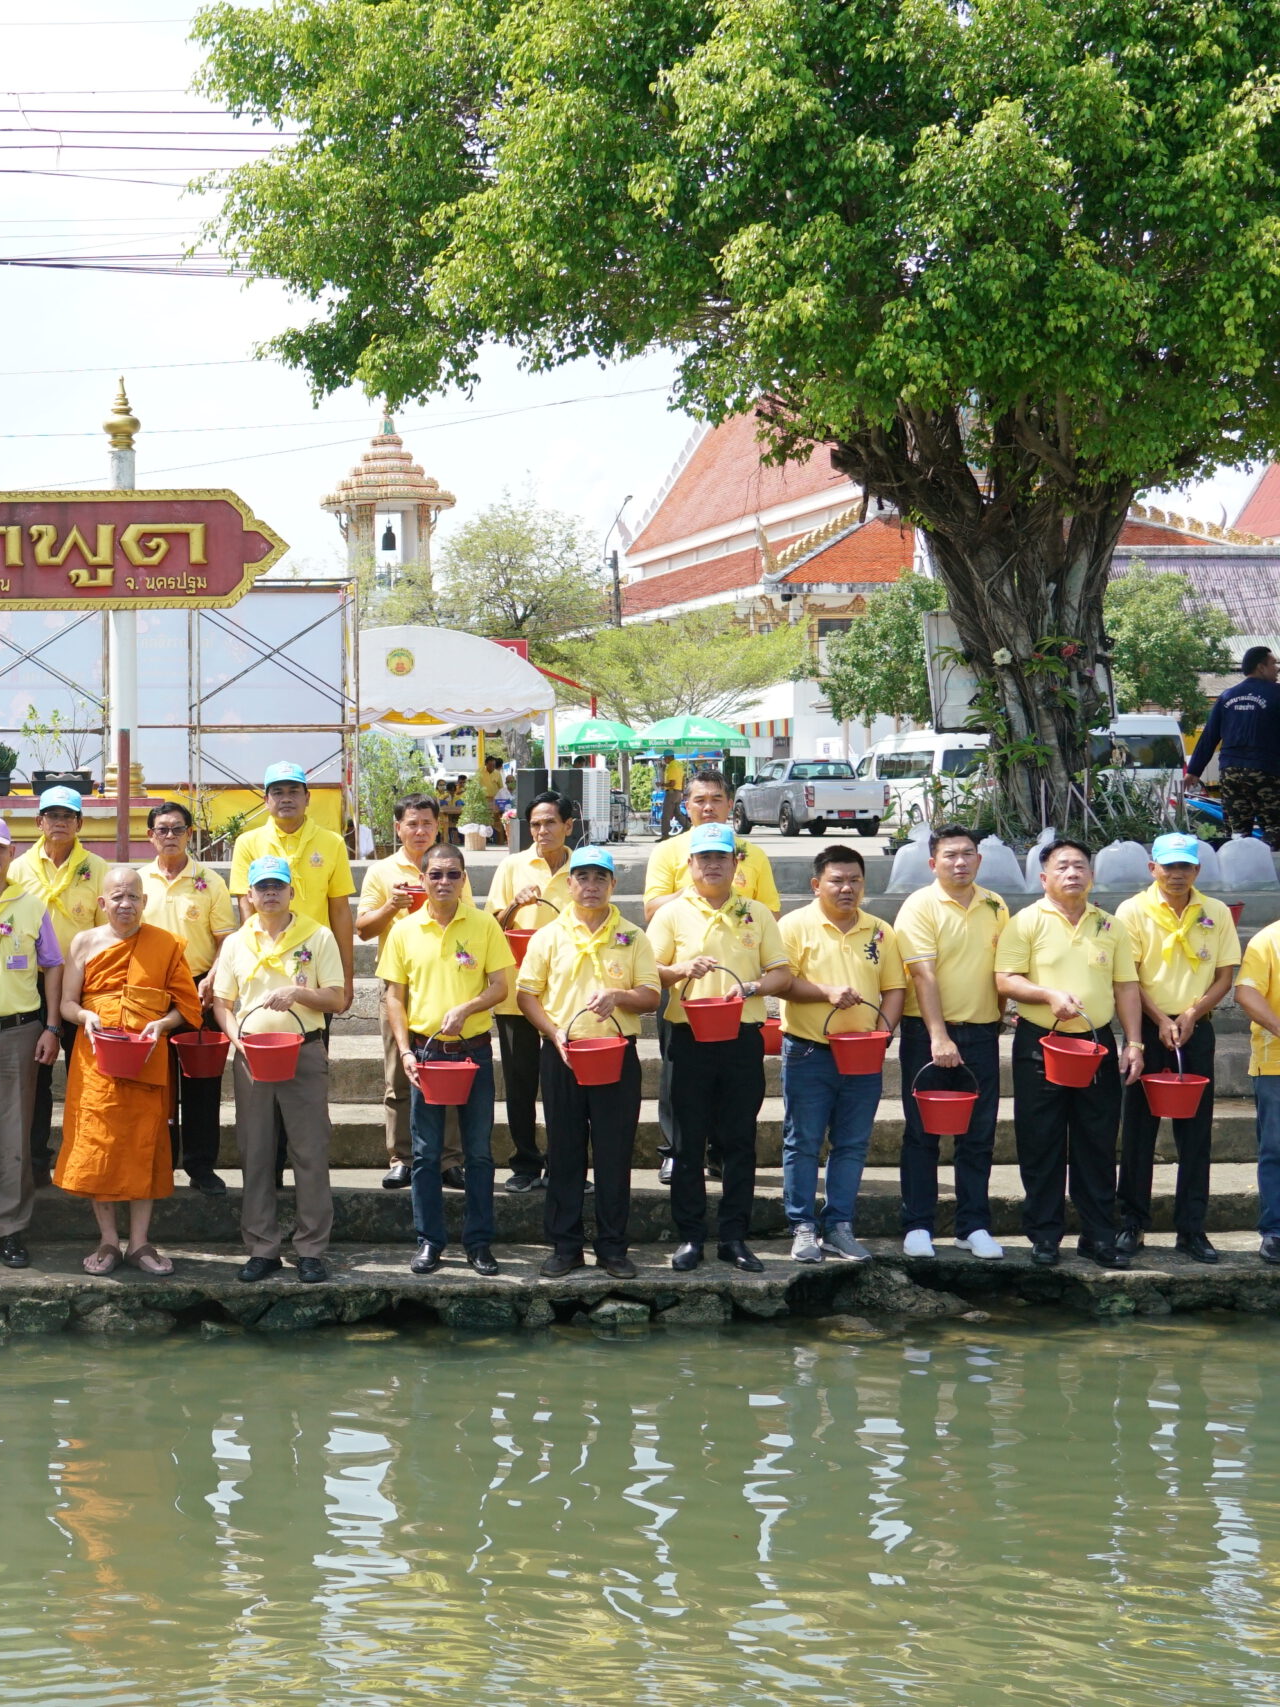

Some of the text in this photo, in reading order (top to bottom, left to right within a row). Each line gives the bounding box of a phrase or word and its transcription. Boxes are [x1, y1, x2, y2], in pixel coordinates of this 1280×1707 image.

[125, 571, 207, 594] จ. นครปฐม
